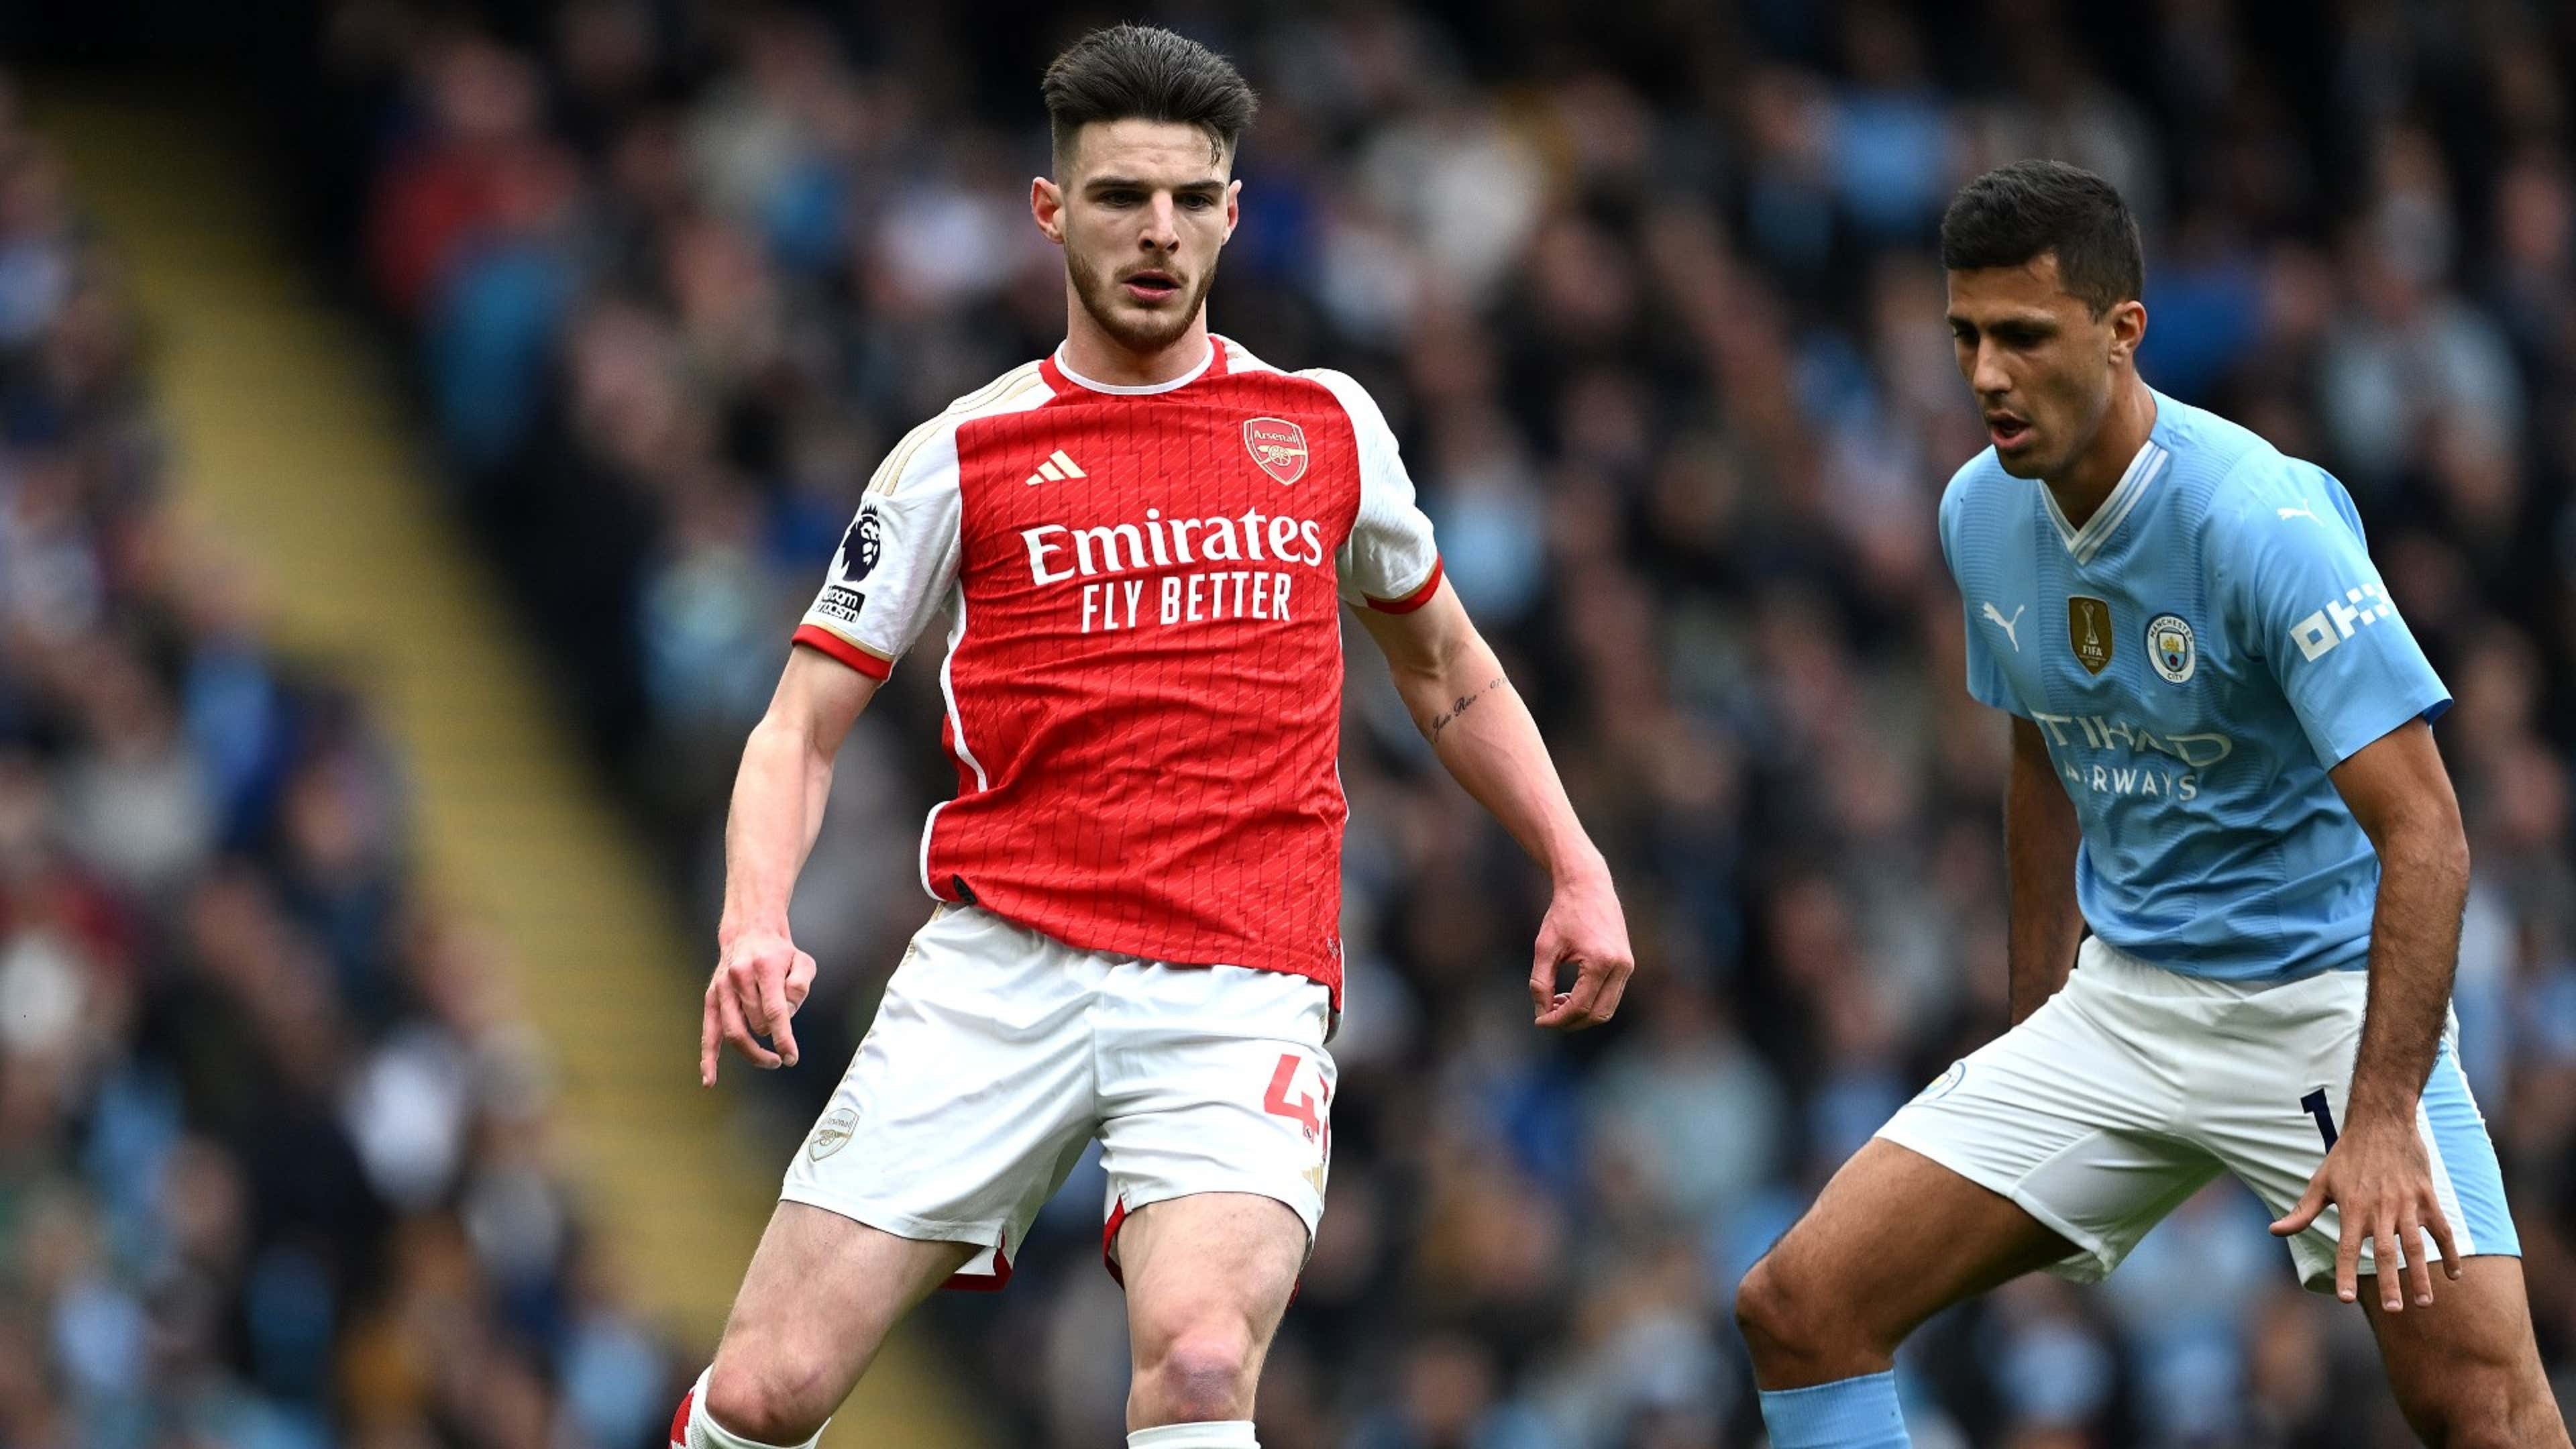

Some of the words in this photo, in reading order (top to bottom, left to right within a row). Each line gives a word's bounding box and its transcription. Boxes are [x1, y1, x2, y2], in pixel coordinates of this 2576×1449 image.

[1254, 430, 1297, 443] Arsenal
[1020, 506, 1323, 586] Emirates
[1081, 580, 1144, 634] FLY
[1160, 571, 1292, 625] BETTER
[2150, 619, 2193, 642] MANCHESTER
[2082, 645, 2103, 657] FIFA
[2167, 673, 2184, 681] CITY
[2031, 710, 2233, 767] TIHAD
